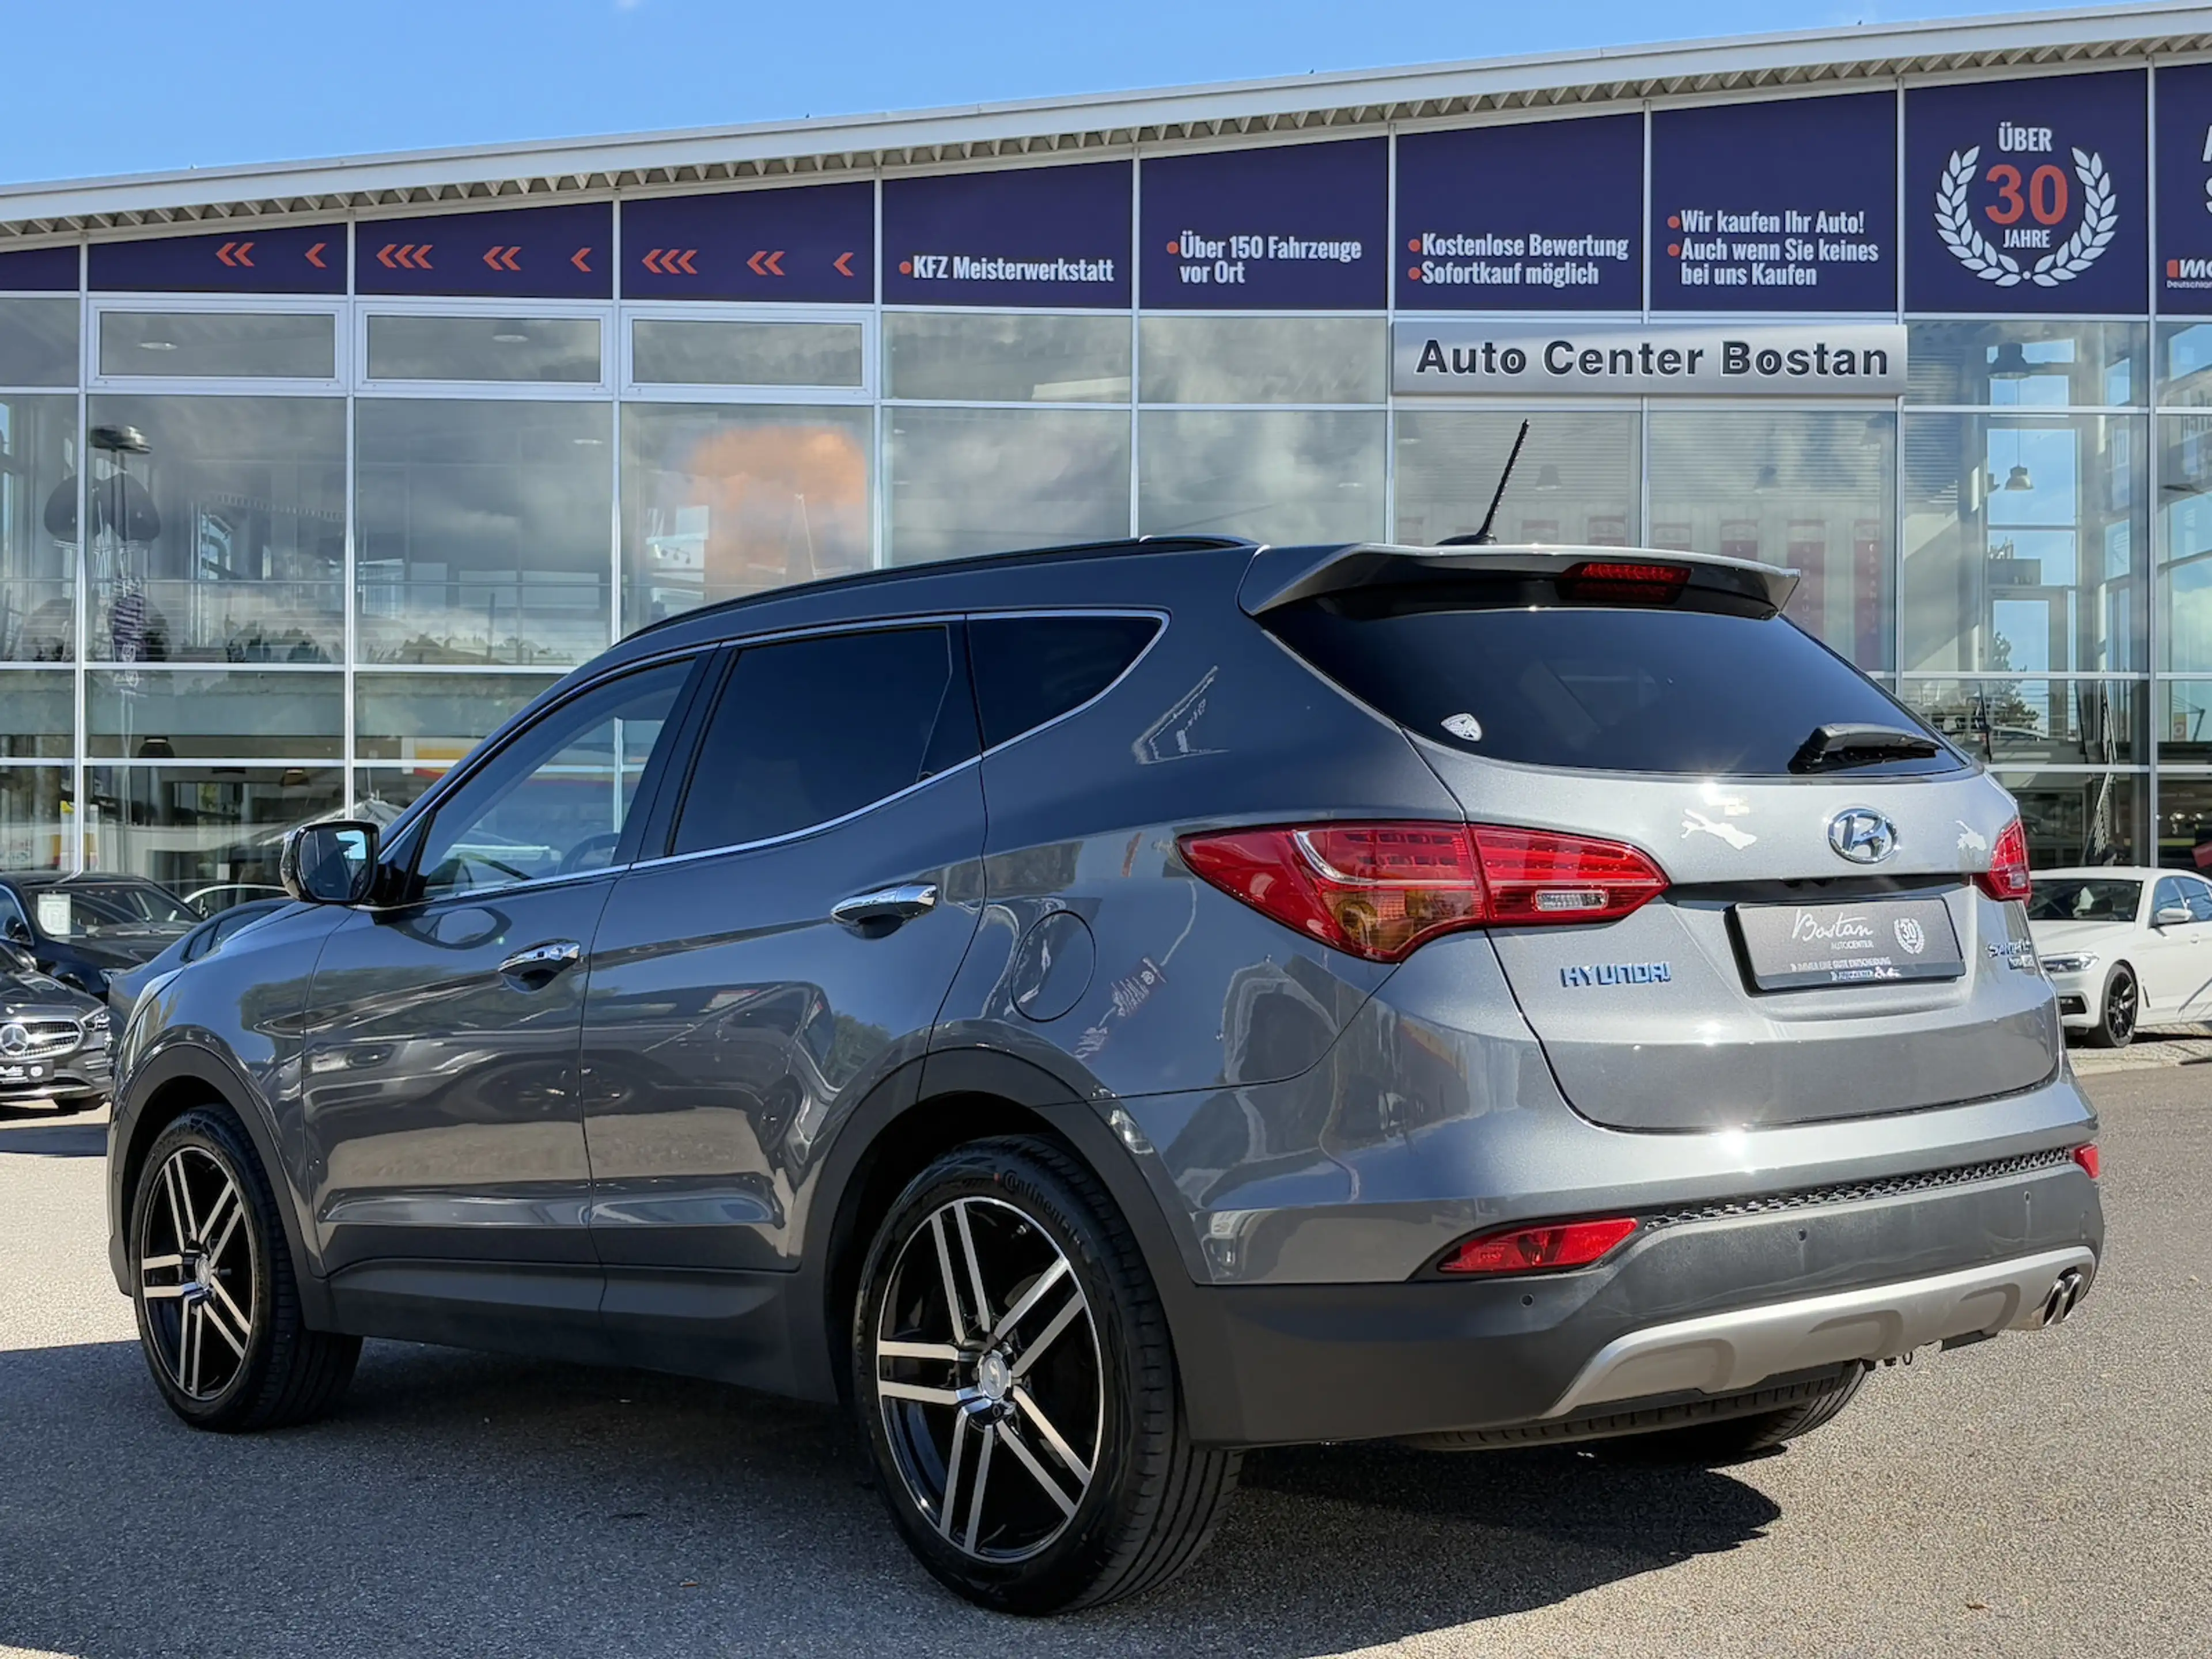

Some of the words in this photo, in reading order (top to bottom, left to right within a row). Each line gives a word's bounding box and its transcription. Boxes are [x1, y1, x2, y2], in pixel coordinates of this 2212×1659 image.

[1998, 122, 2052, 151] ÜBER
[1985, 164, 2068, 225] 30
[1680, 210, 1713, 232] Wir
[1717, 210, 1780, 233] kaufen
[1785, 210, 1812, 233] Ihr
[1815, 210, 1864, 233] Auto!
[1180, 230, 1226, 259] Über
[1229, 235, 1263, 259] 150
[1268, 236, 1362, 263] Fahrzeuge
[1422, 233, 1524, 257] Kostenlose
[1529, 233, 1629, 260] Bewertung
[1681, 237, 1728, 260] Auch
[1732, 243, 1780, 260] wenn
[1785, 238, 1814, 261] Sie
[1819, 238, 1878, 262] keines
[2003, 229, 2051, 248] JAHRE
[913, 255, 949, 279] KFZ
[953, 256, 1114, 282] Meisterwerkstatt
[1180, 266, 1211, 283] vor
[1214, 260, 1245, 283] Ort
[1422, 261, 1522, 285] Sofortkauf
[1525, 262, 1599, 288] möglich
[1681, 262, 1709, 285] bei
[1714, 268, 1747, 285] uns
[1752, 263, 1817, 286] Kaufen
[1416, 339, 1527, 375] Auto
[1544, 340, 1704, 376] Center
[1722, 341, 1888, 376] Bostan
[1791, 909, 1874, 942] Bostan
[1900, 922, 1916, 940] 30
[1559, 961, 1672, 987] HYUNDAI
[1003, 1169, 1078, 1243] Continental
